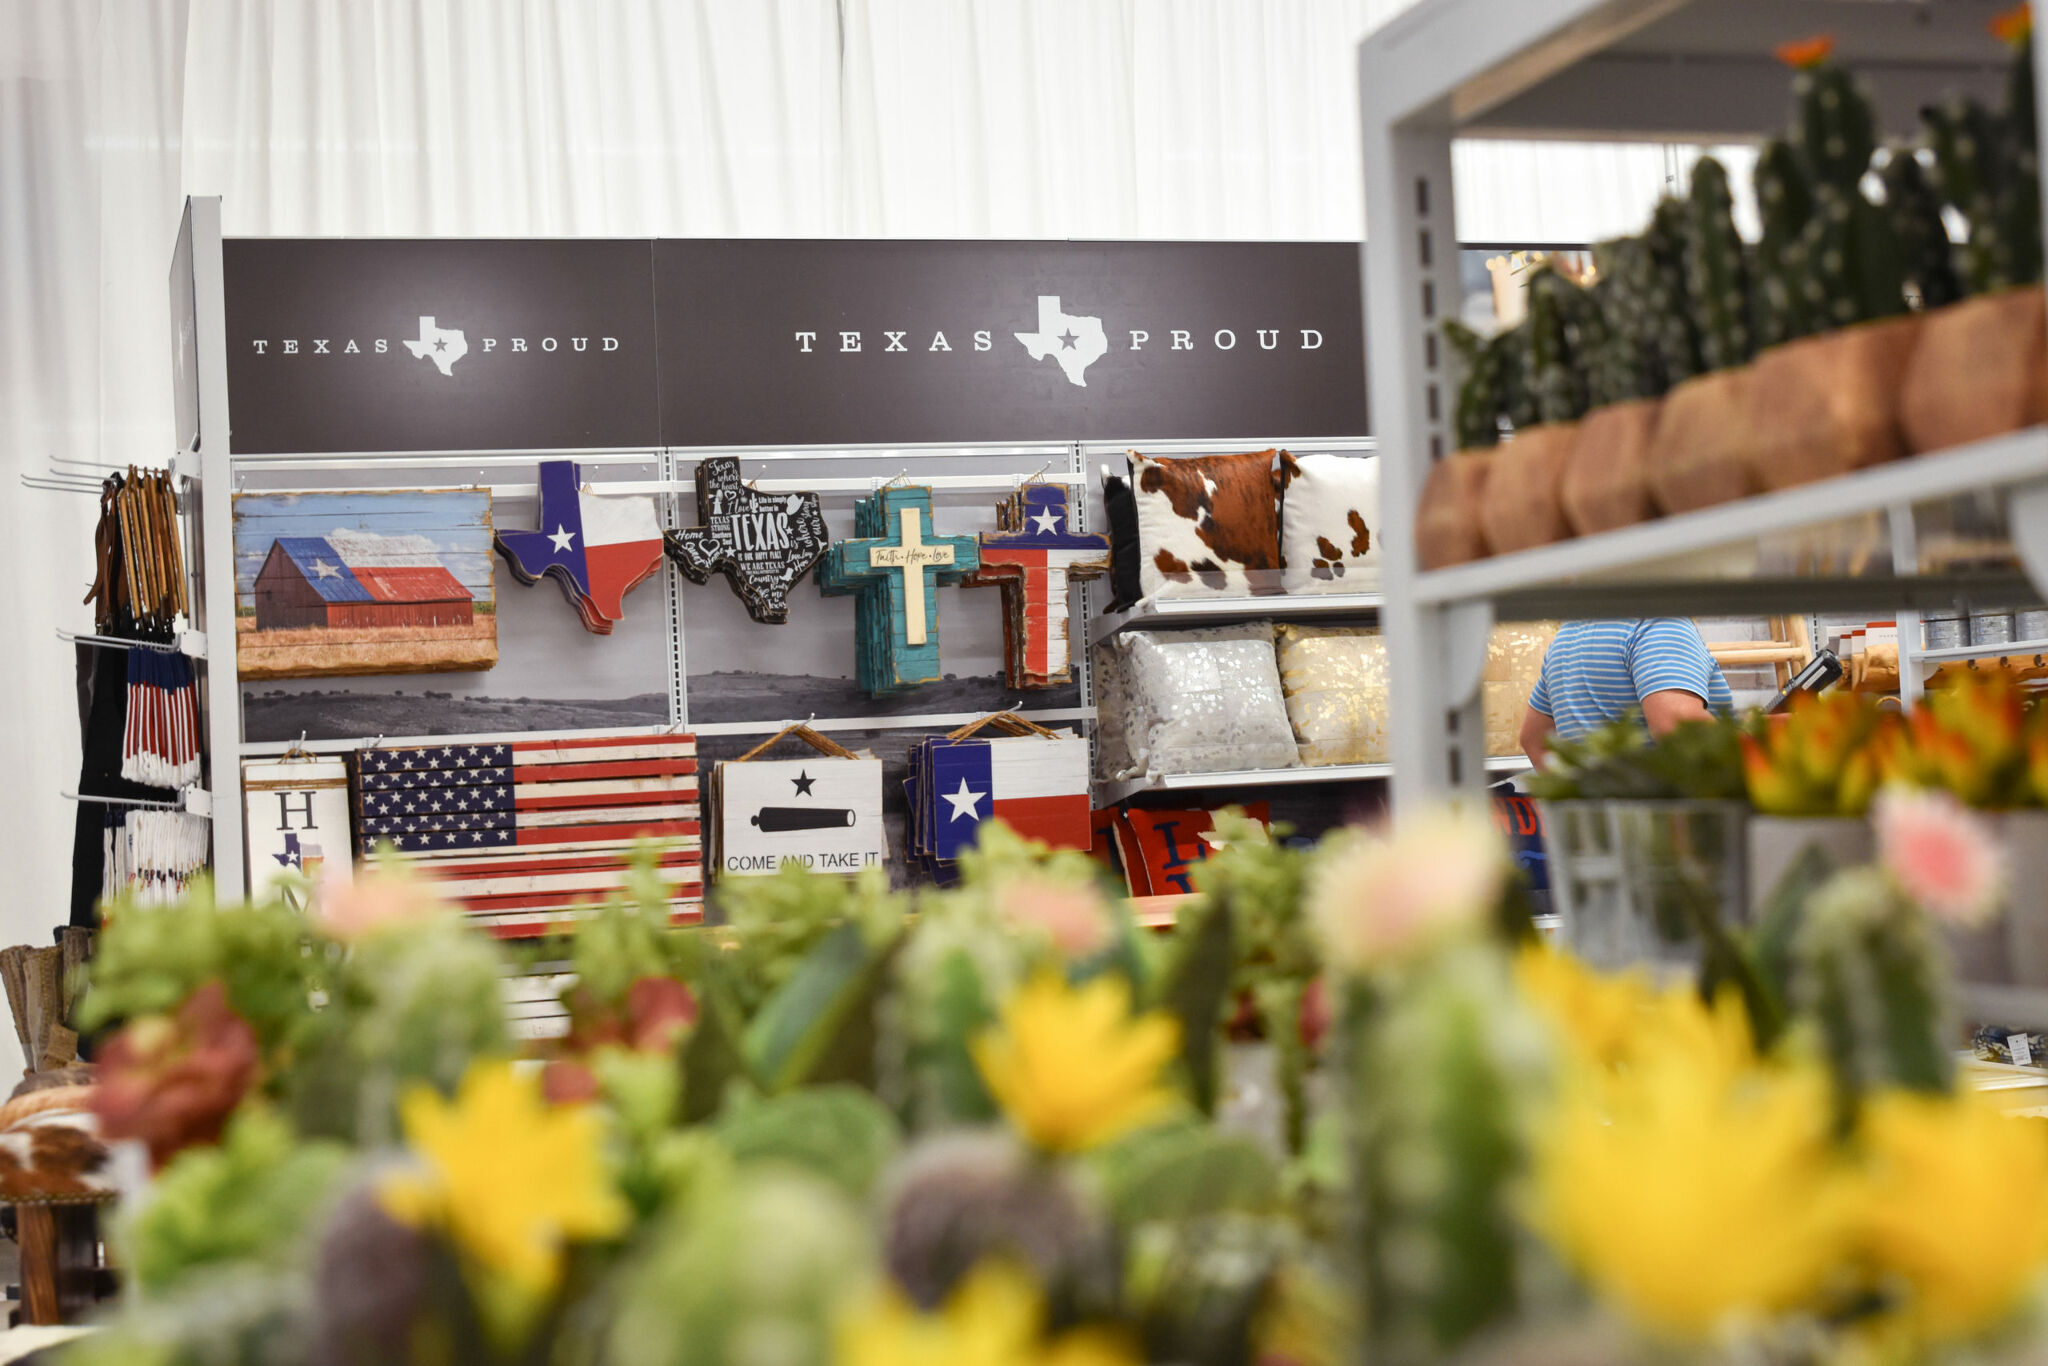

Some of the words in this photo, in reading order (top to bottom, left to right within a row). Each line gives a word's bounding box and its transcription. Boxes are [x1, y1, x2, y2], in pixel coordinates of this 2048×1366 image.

[254, 339, 387, 353] TEXAS
[483, 338, 618, 352] PROUD
[796, 331, 992, 352] TEXAS
[1130, 330, 1322, 350] PROUD
[708, 459, 735, 476] Texas
[709, 478, 720, 490] the
[721, 480, 739, 490] heart
[718, 470, 739, 482] where
[710, 515, 730, 525] TEXAS
[674, 529, 704, 540] Home
[730, 512, 790, 551] TEXAS
[796, 517, 813, 548] where
[682, 541, 705, 565] Sweet
[875, 549, 900, 564] Faith
[905, 548, 927, 565] Hope
[932, 547, 950, 562] Love
[740, 562, 751, 571] WE
[752, 562, 764, 570] ARE
[765, 561, 785, 569] TEXAS
[749, 574, 780, 585] Country
[727, 855, 776, 871] COME
[780, 854, 814, 870] AND
[819, 852, 860, 868] TAKE
[865, 851, 879, 867] IT
